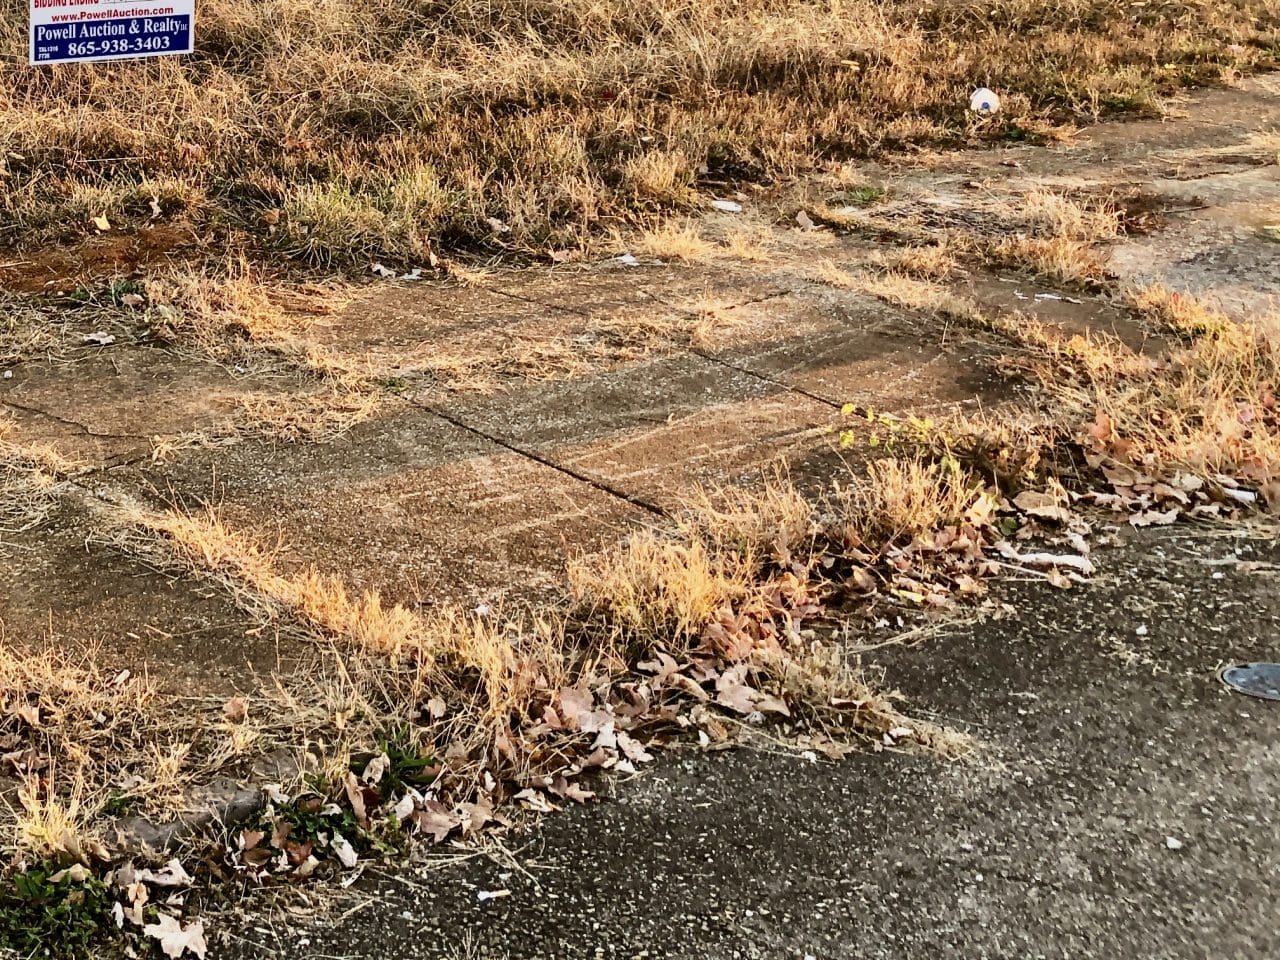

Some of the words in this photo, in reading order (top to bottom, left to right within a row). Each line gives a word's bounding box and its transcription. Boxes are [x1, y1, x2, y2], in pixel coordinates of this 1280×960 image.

[51, 6, 174, 22] www.PowellAuction.com
[37, 24, 76, 41] Powell
[79, 21, 125, 38] Auction
[129, 19, 141, 34] &
[143, 17, 181, 35] Realty
[68, 36, 170, 56] 865-938-3403
